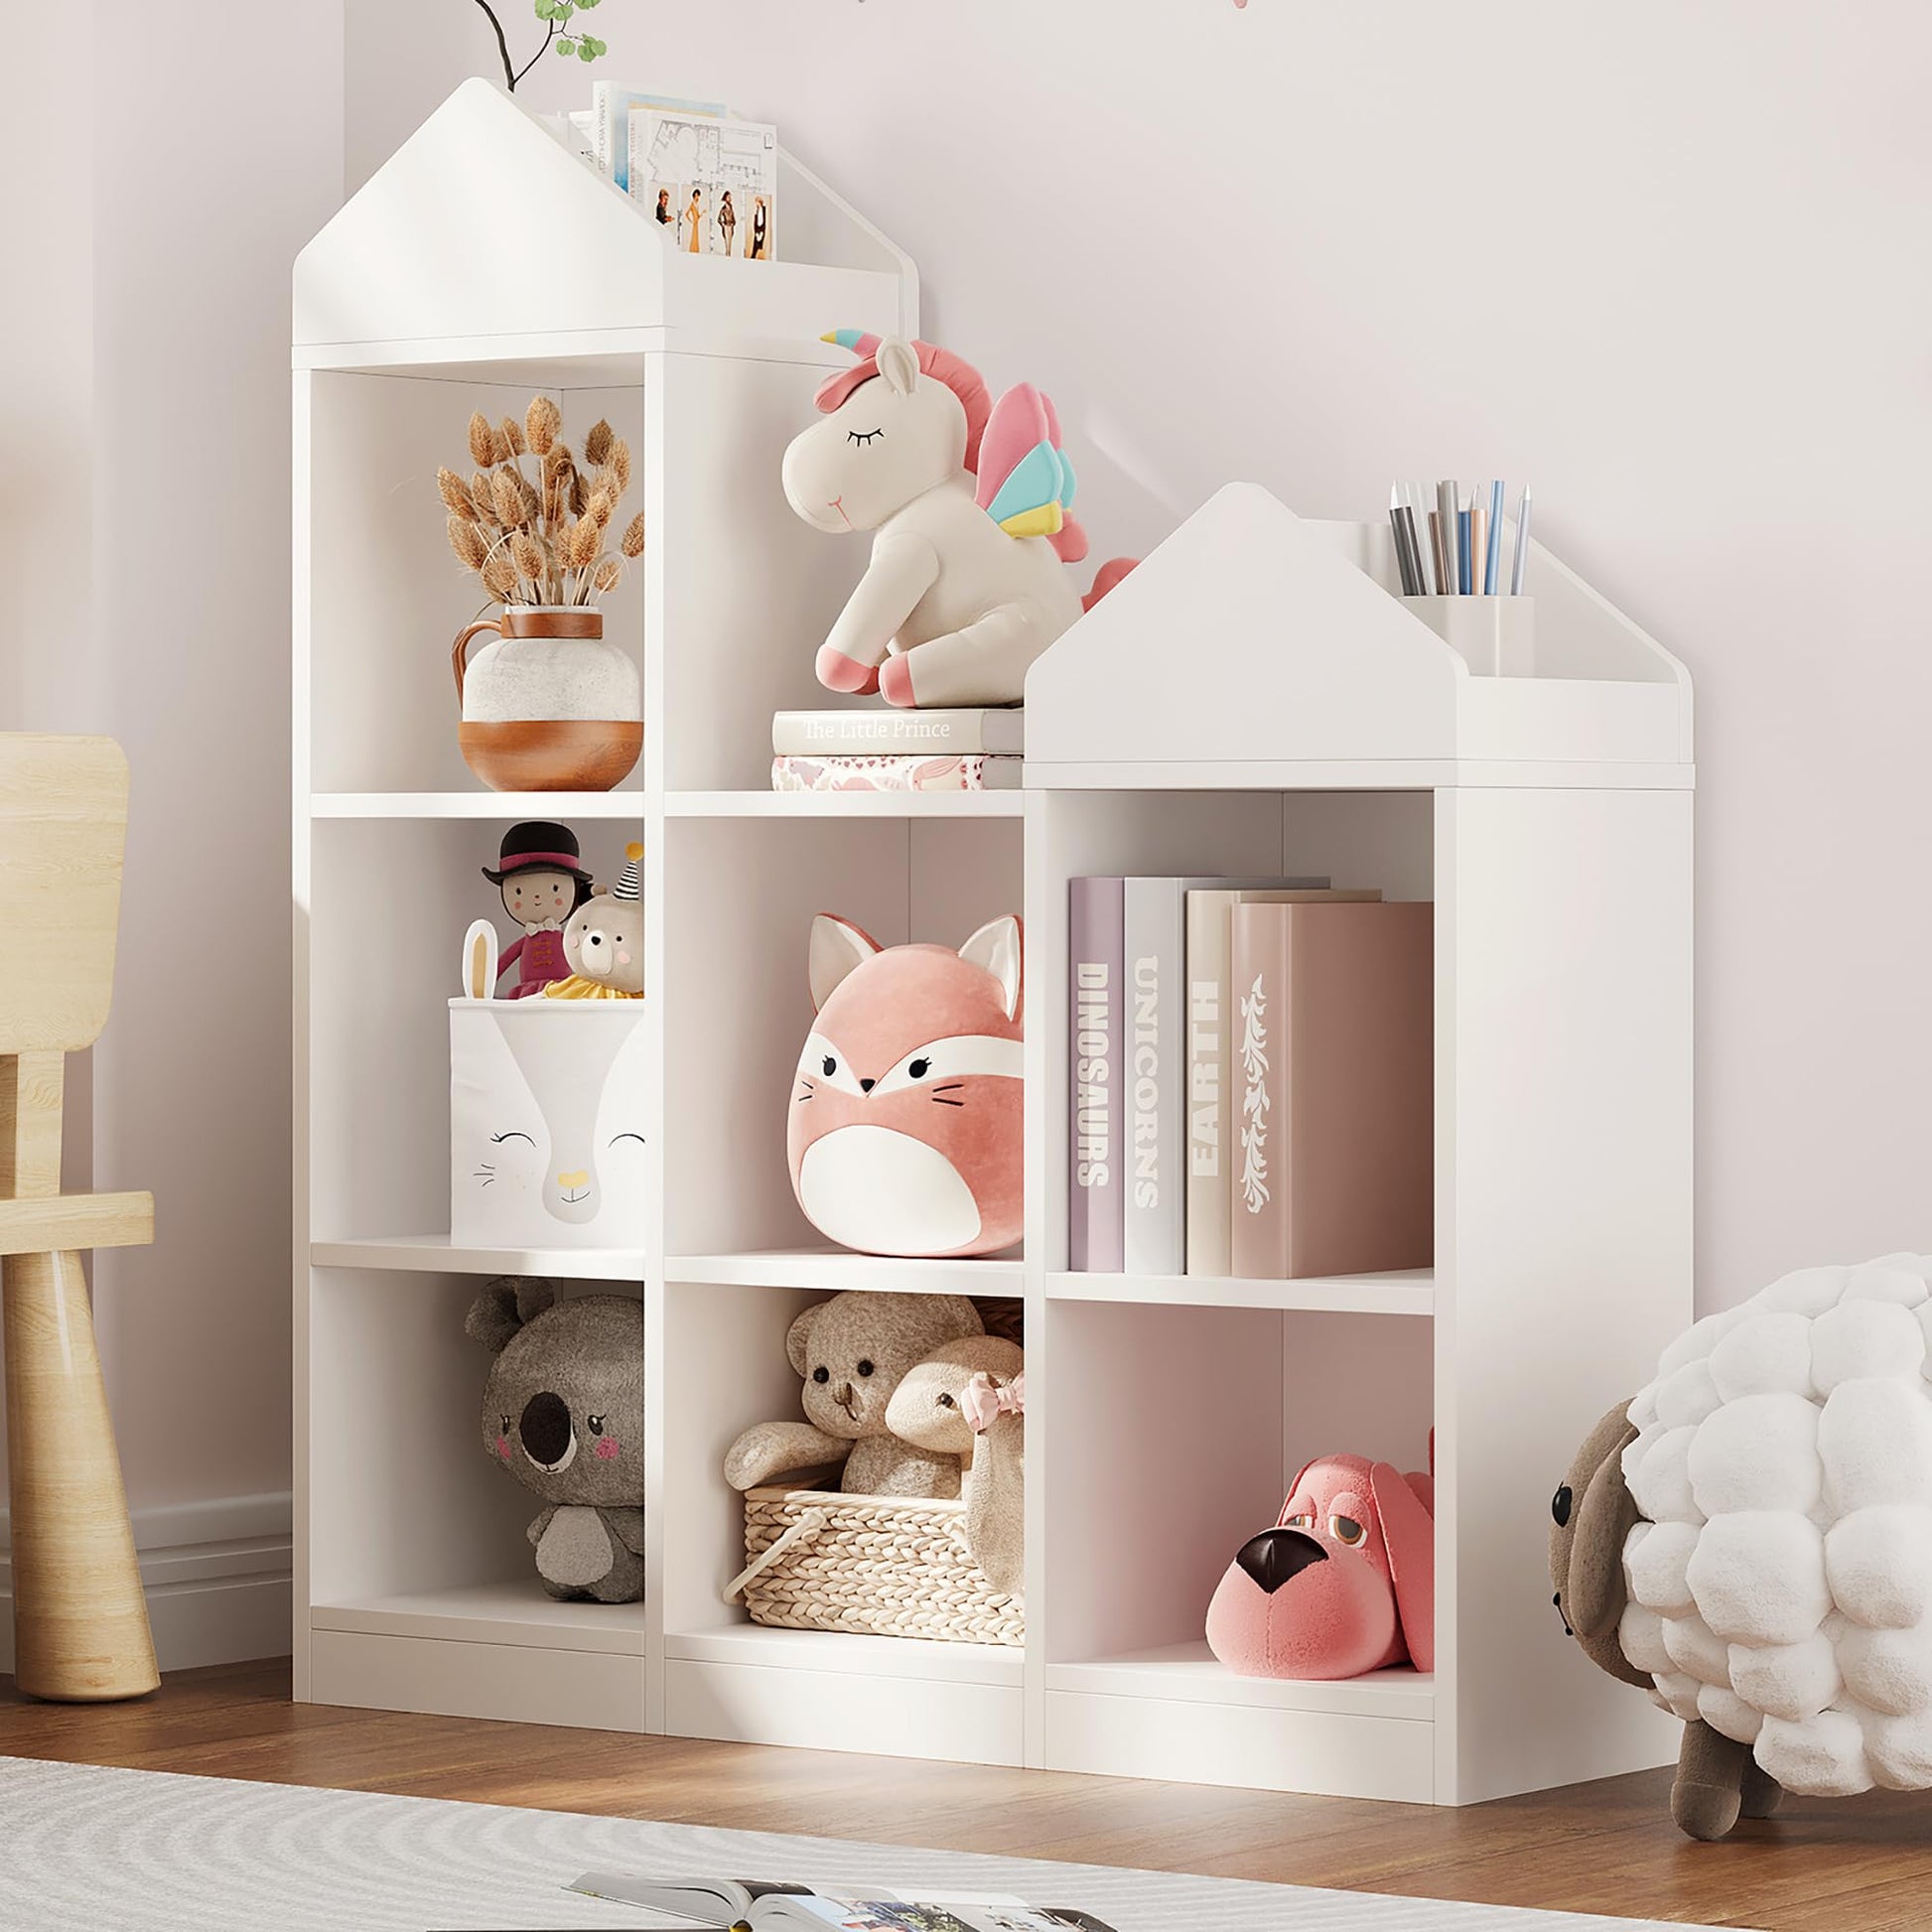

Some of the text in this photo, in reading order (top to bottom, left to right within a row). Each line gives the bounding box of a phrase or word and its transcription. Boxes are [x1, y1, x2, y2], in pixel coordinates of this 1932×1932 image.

[803, 719, 950, 739] The Little Prince
[1077, 962, 1110, 1188] DINOSAURS
[1134, 954, 1160, 1210] UNICORNS
[1191, 980, 1219, 1177] EARTH
